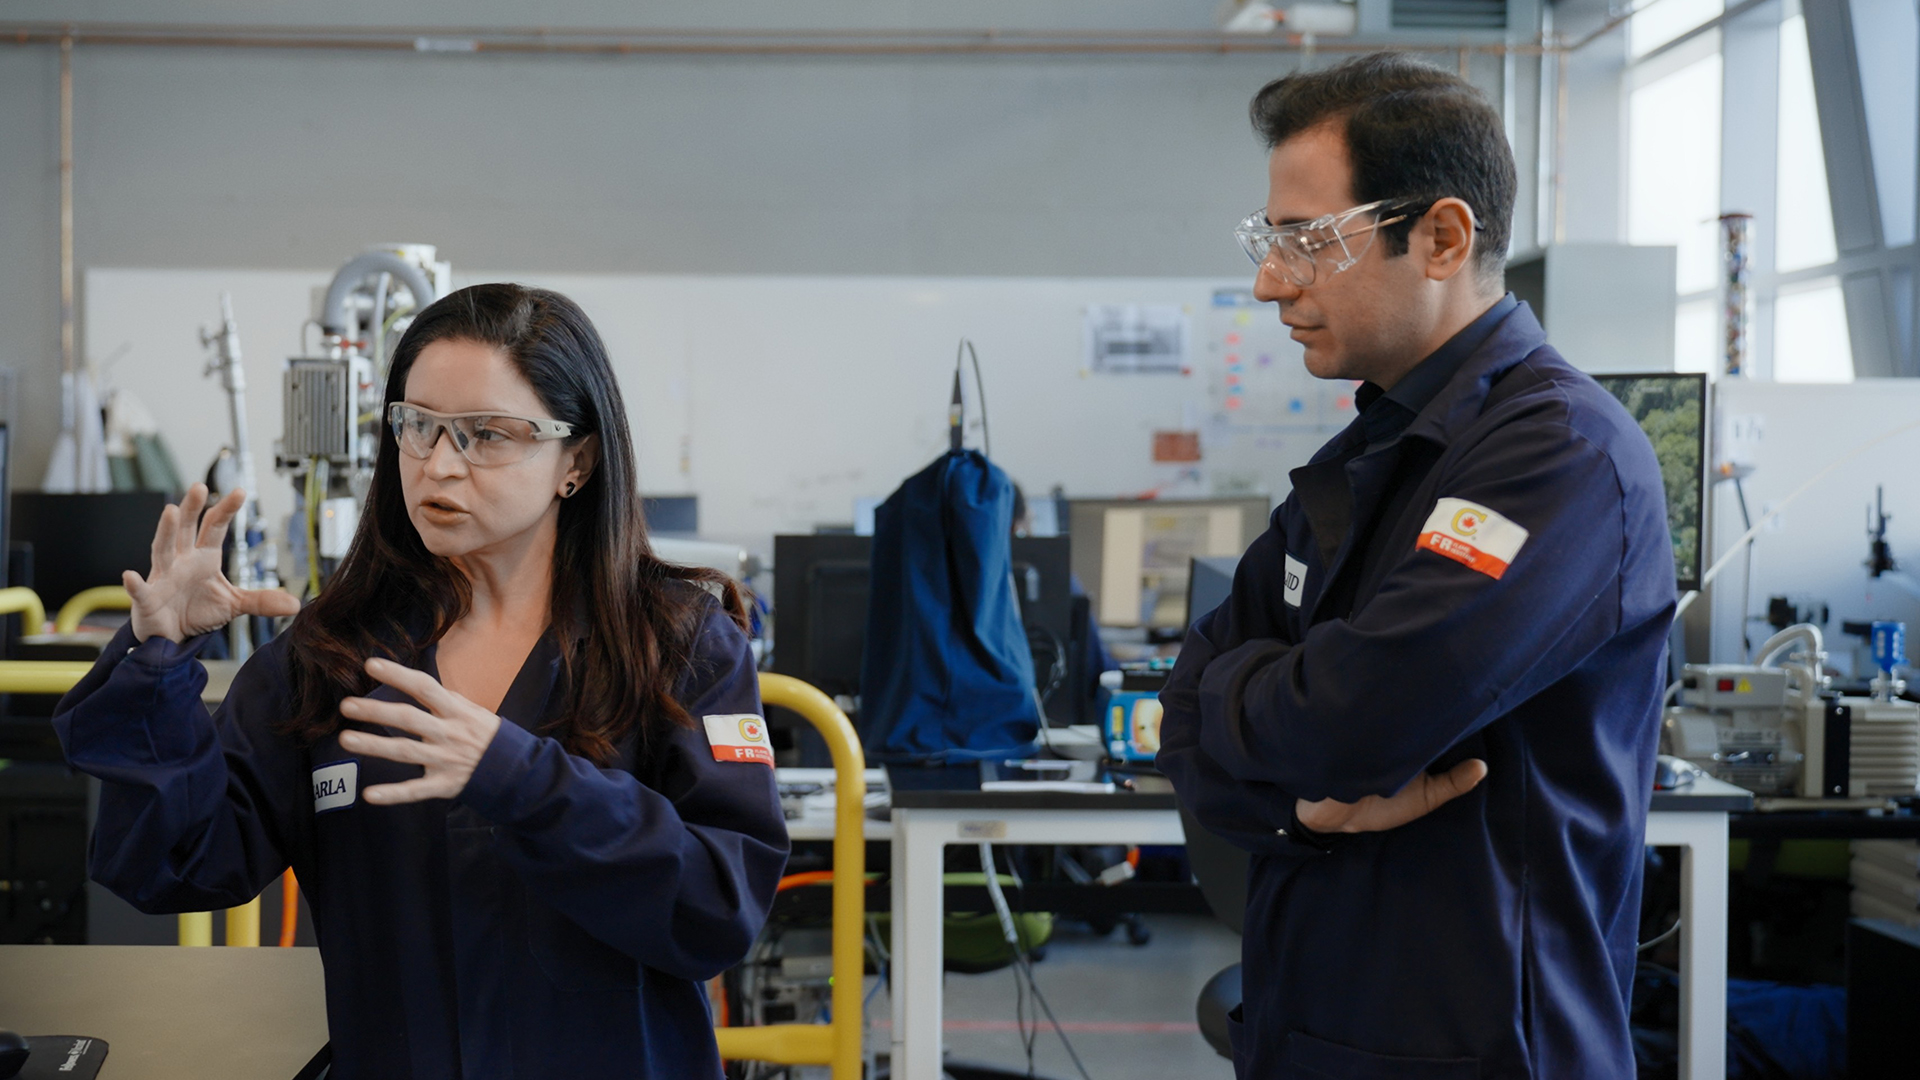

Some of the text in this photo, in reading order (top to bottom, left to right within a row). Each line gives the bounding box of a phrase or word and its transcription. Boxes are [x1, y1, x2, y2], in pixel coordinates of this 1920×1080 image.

[1430, 534, 1452, 551] FR
[734, 748, 755, 758] FR
[313, 777, 346, 800] ARLA
